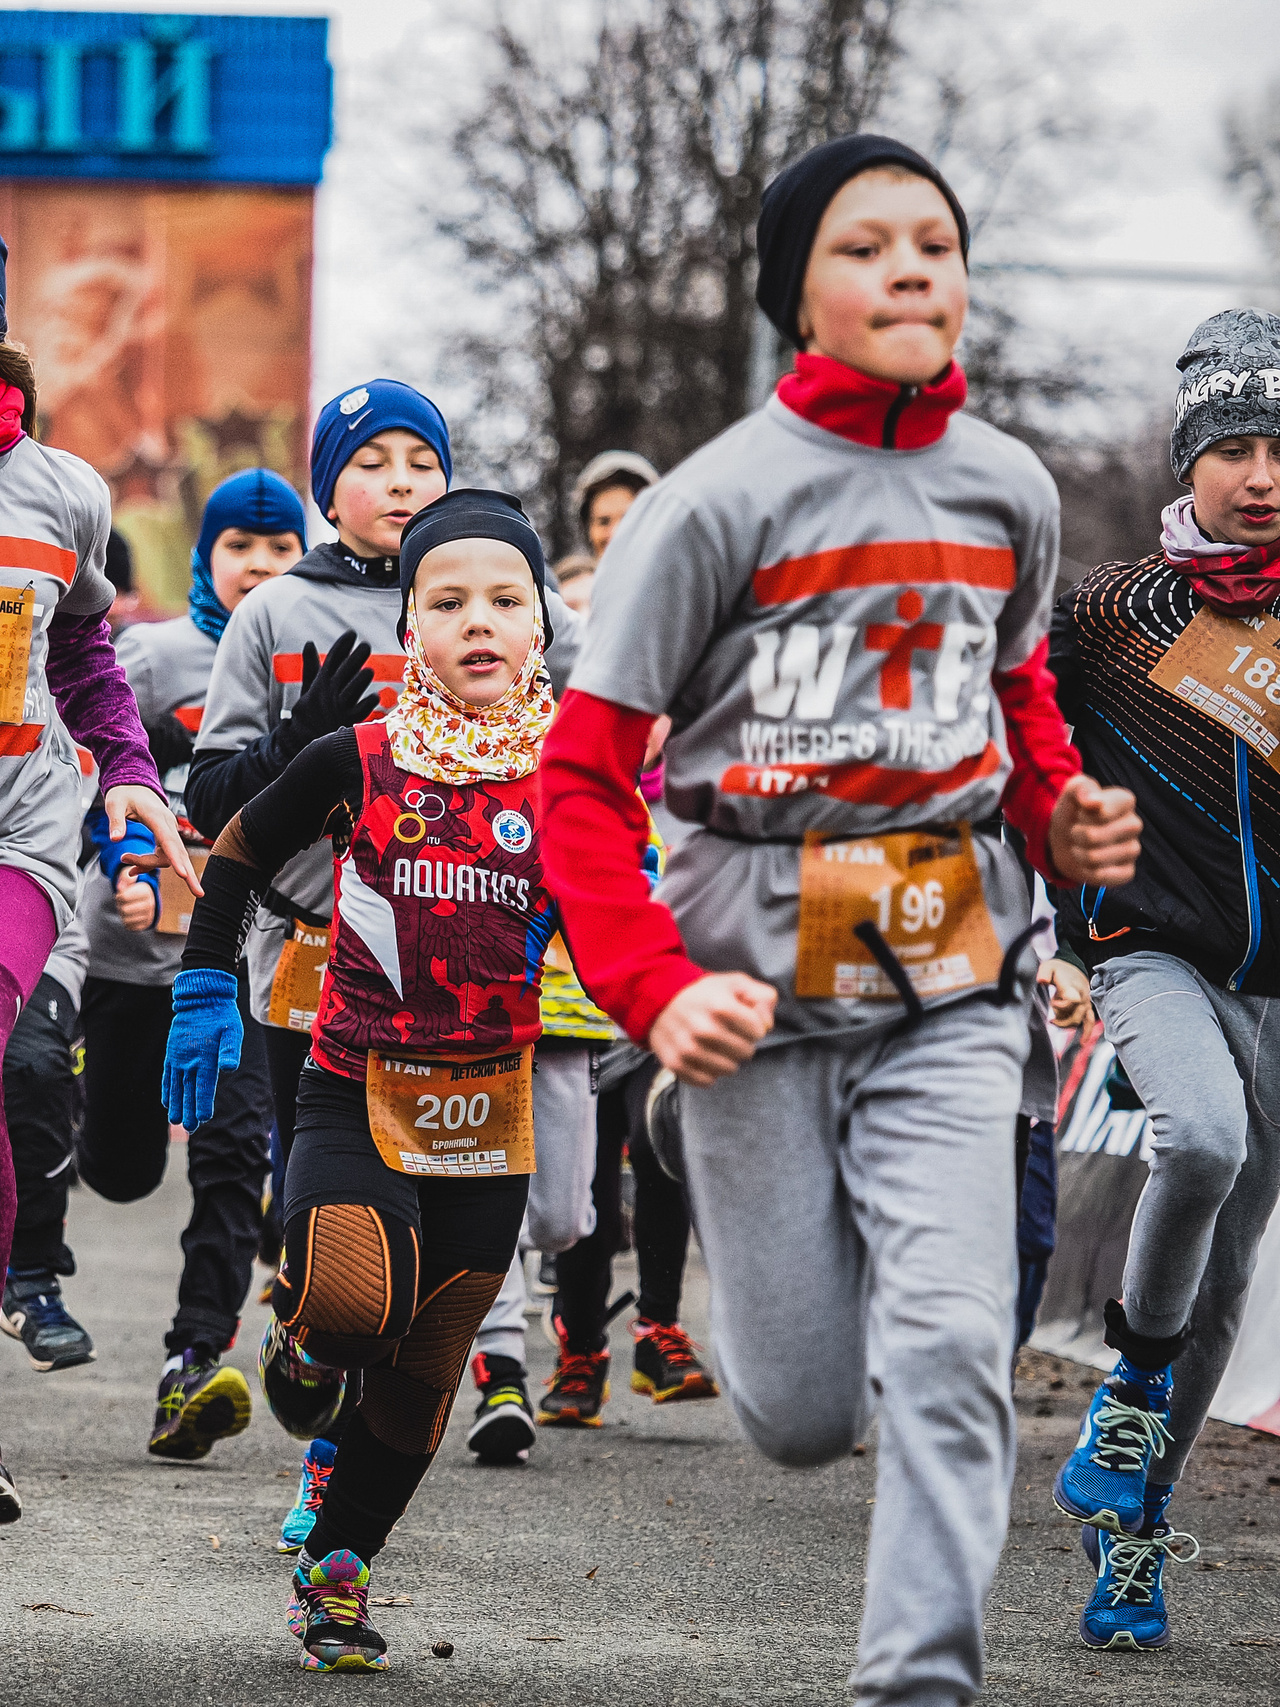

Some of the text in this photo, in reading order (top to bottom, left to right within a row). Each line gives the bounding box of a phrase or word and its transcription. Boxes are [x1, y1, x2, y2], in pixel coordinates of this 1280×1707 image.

[1176, 369, 1252, 426] ANGRY
[1223, 684, 1267, 717] БРОННИЦЫ
[427, 836, 440, 845] ITU
[393, 858, 529, 911] AQUATICS
[871, 880, 947, 934] 196
[450, 1065, 497, 1082] ДЕТСКИЙ
[414, 1092, 490, 1130] 200
[432, 1136, 478, 1150] БРОННИЦЫ
